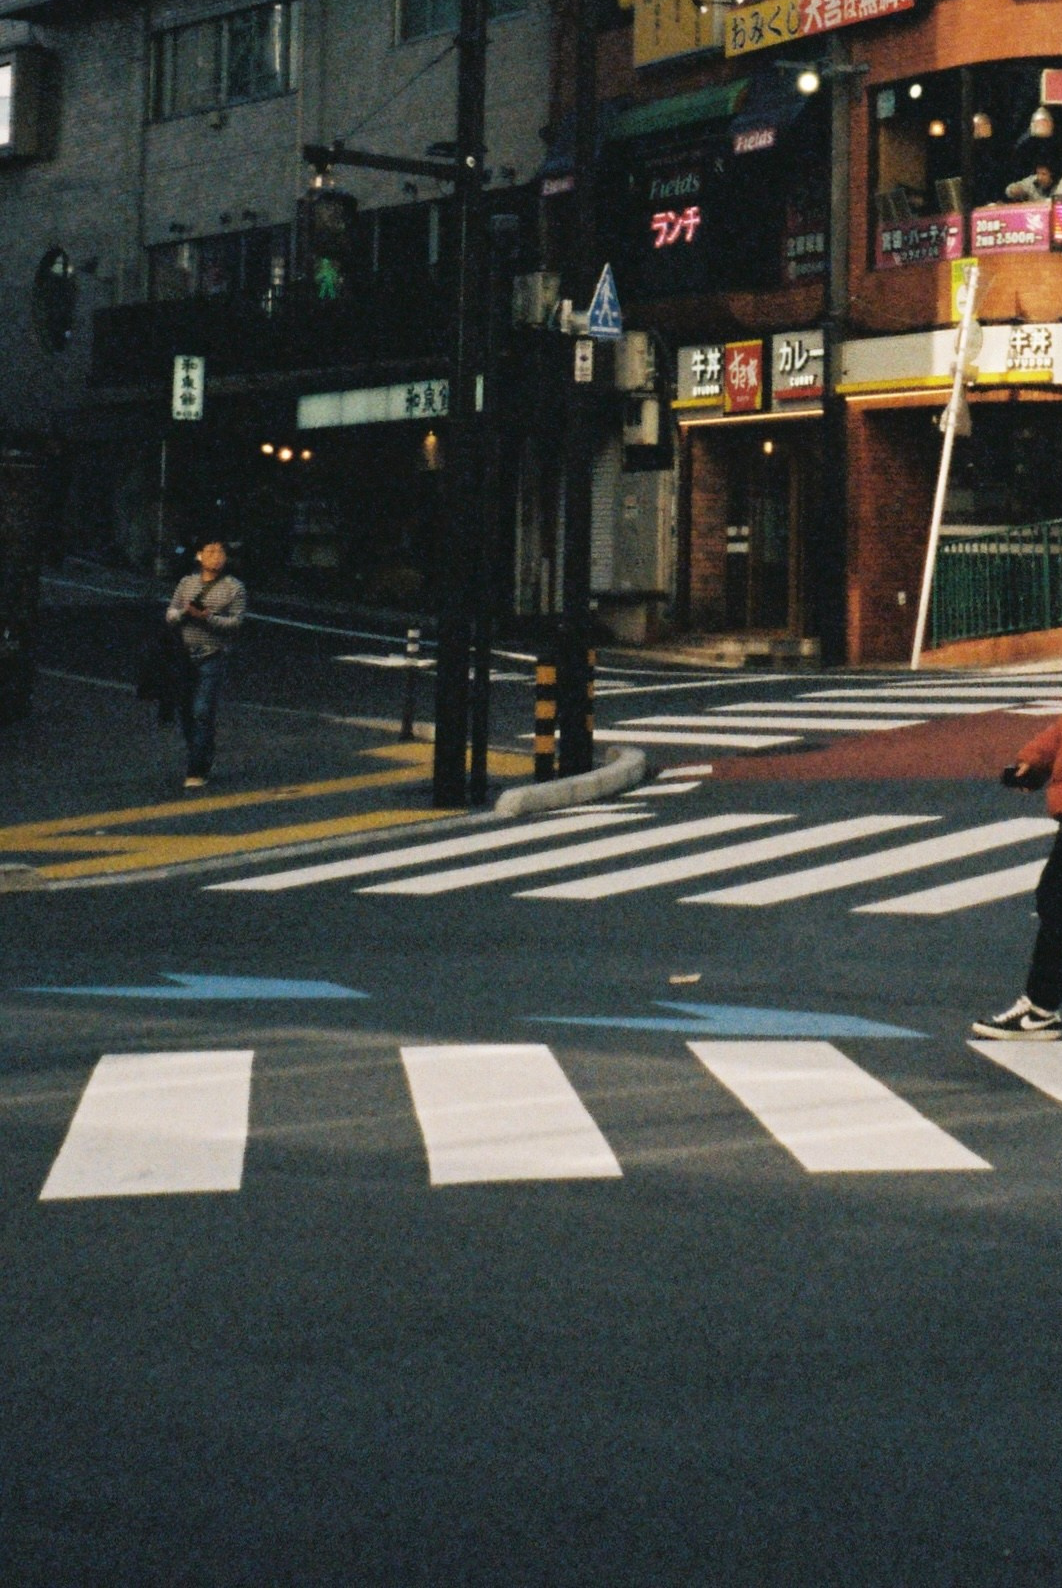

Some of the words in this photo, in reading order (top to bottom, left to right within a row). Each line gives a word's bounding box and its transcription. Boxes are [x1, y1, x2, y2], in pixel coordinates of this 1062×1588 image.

[652, 206, 701, 249] ランチ
[778, 339, 825, 372] カレー
[1010, 328, 1052, 355] 牛丼
[691, 348, 722, 380] 牛丼
[728, 349, 758, 391] すき家
